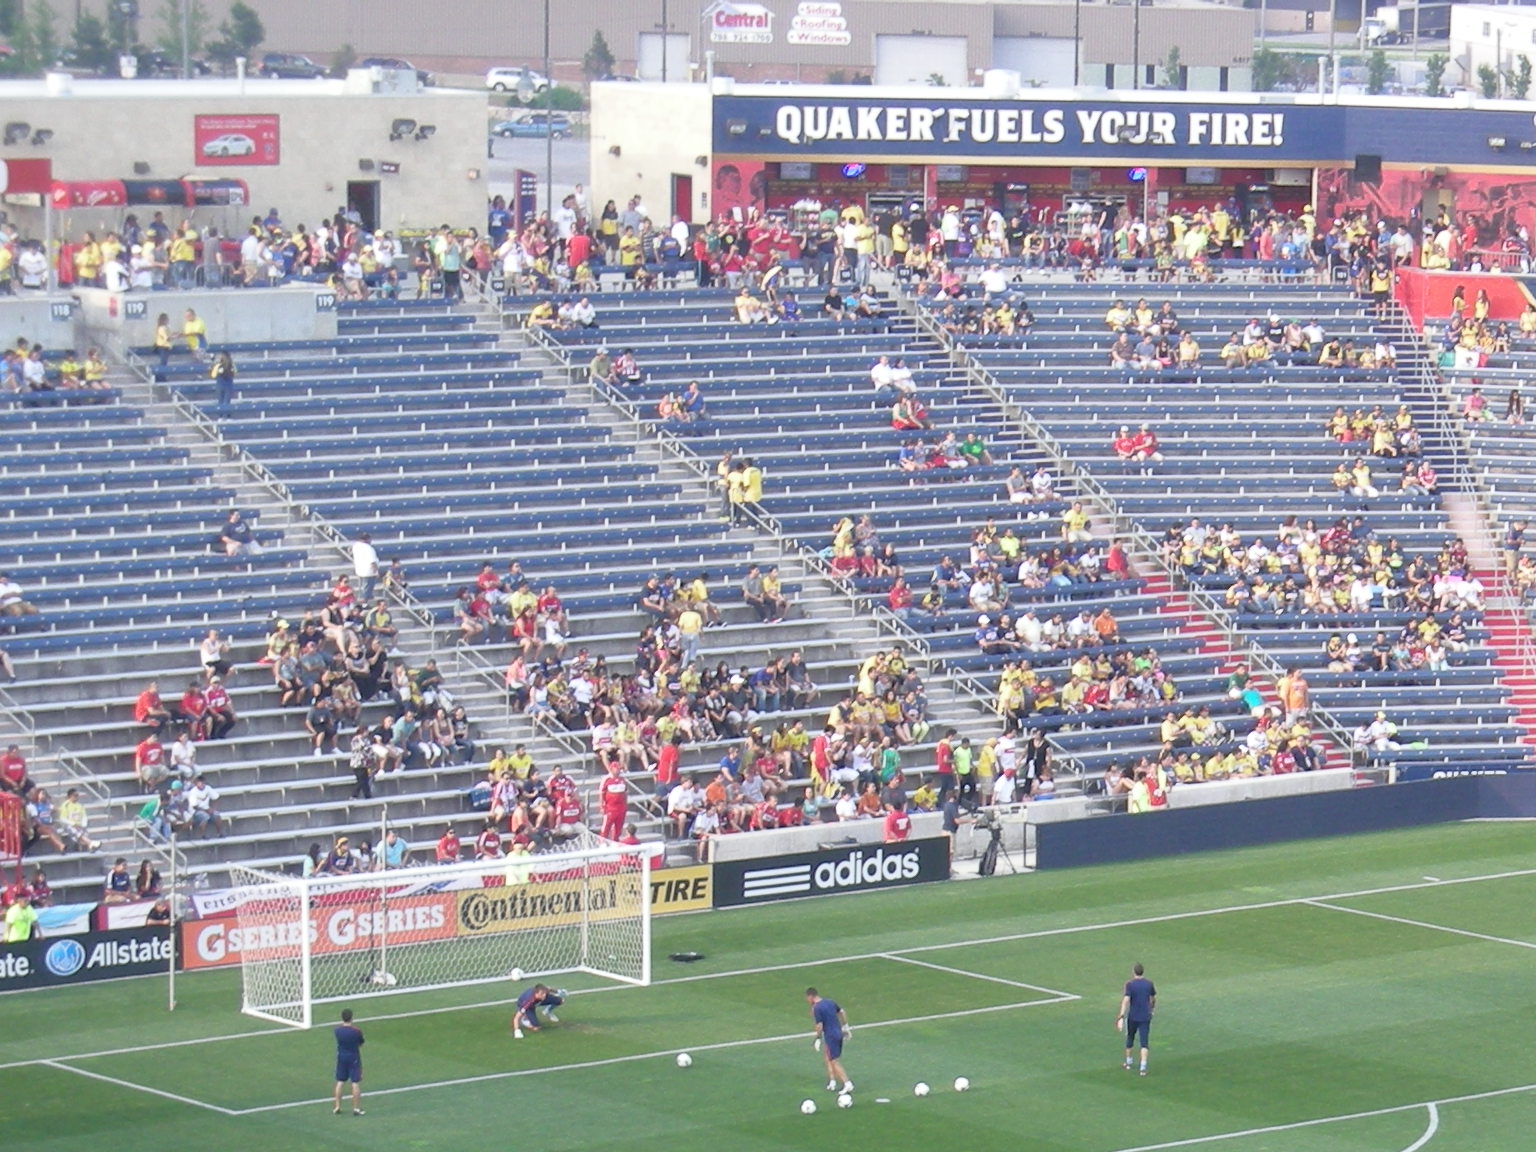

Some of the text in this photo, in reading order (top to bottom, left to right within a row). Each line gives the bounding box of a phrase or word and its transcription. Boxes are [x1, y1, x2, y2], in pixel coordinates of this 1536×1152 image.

[715, 10, 768, 28] Central
[801, 19, 842, 31] Roofing
[798, 33, 848, 43] Windows
[776, 105, 1284, 146] QUAKER FUELS YOUR FIRE!
[317, 296, 335, 307] 119
[814, 848, 919, 889] adidas
[650, 876, 709, 905] TIRE
[197, 904, 445, 962] G SERIES G SERIES
[87, 936, 173, 969] Allstate
